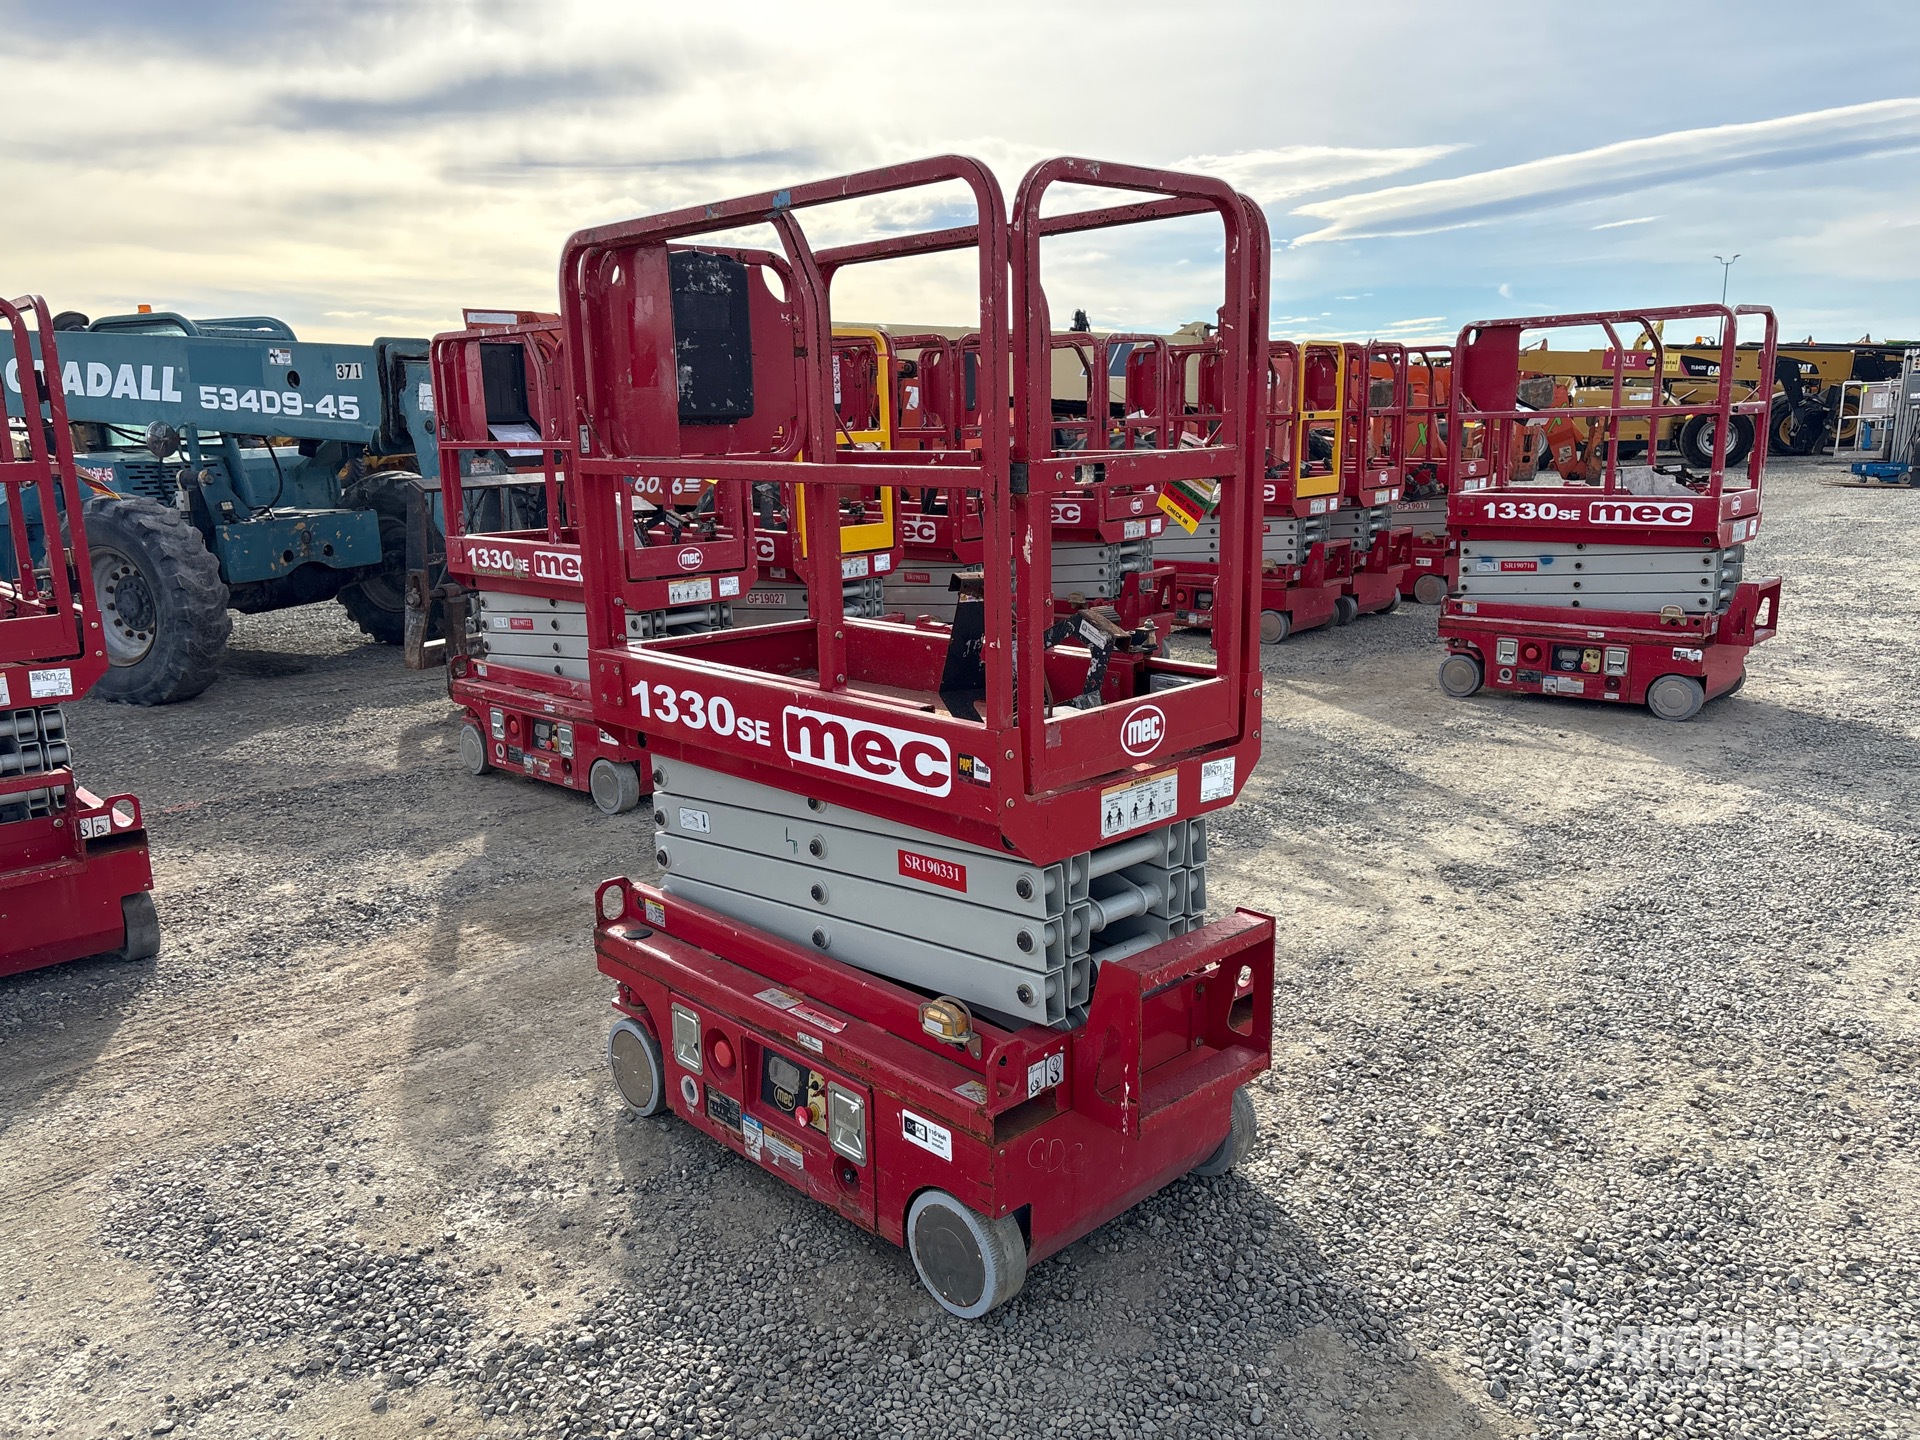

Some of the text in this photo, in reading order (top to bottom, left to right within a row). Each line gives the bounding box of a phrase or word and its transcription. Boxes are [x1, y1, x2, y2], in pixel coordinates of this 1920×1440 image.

[5, 357, 182, 403] GADALL
[336, 364, 361, 379] 371
[1707, 366, 1721, 377] CA
[199, 385, 360, 420] 534D9-45
[634, 477, 683, 495] 606
[1051, 506, 1080, 521] ec
[1166, 504, 1183, 520] CHECK
[1482, 502, 1581, 521] 1330SE
[1591, 503, 1691, 523] mec
[902, 523, 937, 541] ec
[467, 547, 530, 572] 1330SE
[534, 554, 580, 578] me
[681, 553, 700, 565] mec
[747, 593, 785, 604] GF19027
[631, 680, 772, 747] 1330SE
[1128, 715, 1160, 746] mec
[785, 711, 950, 789] mec
[904, 854, 960, 881] SR190331
[776, 1089, 794, 1107] mec
[906, 1121, 925, 1138] DC AC
